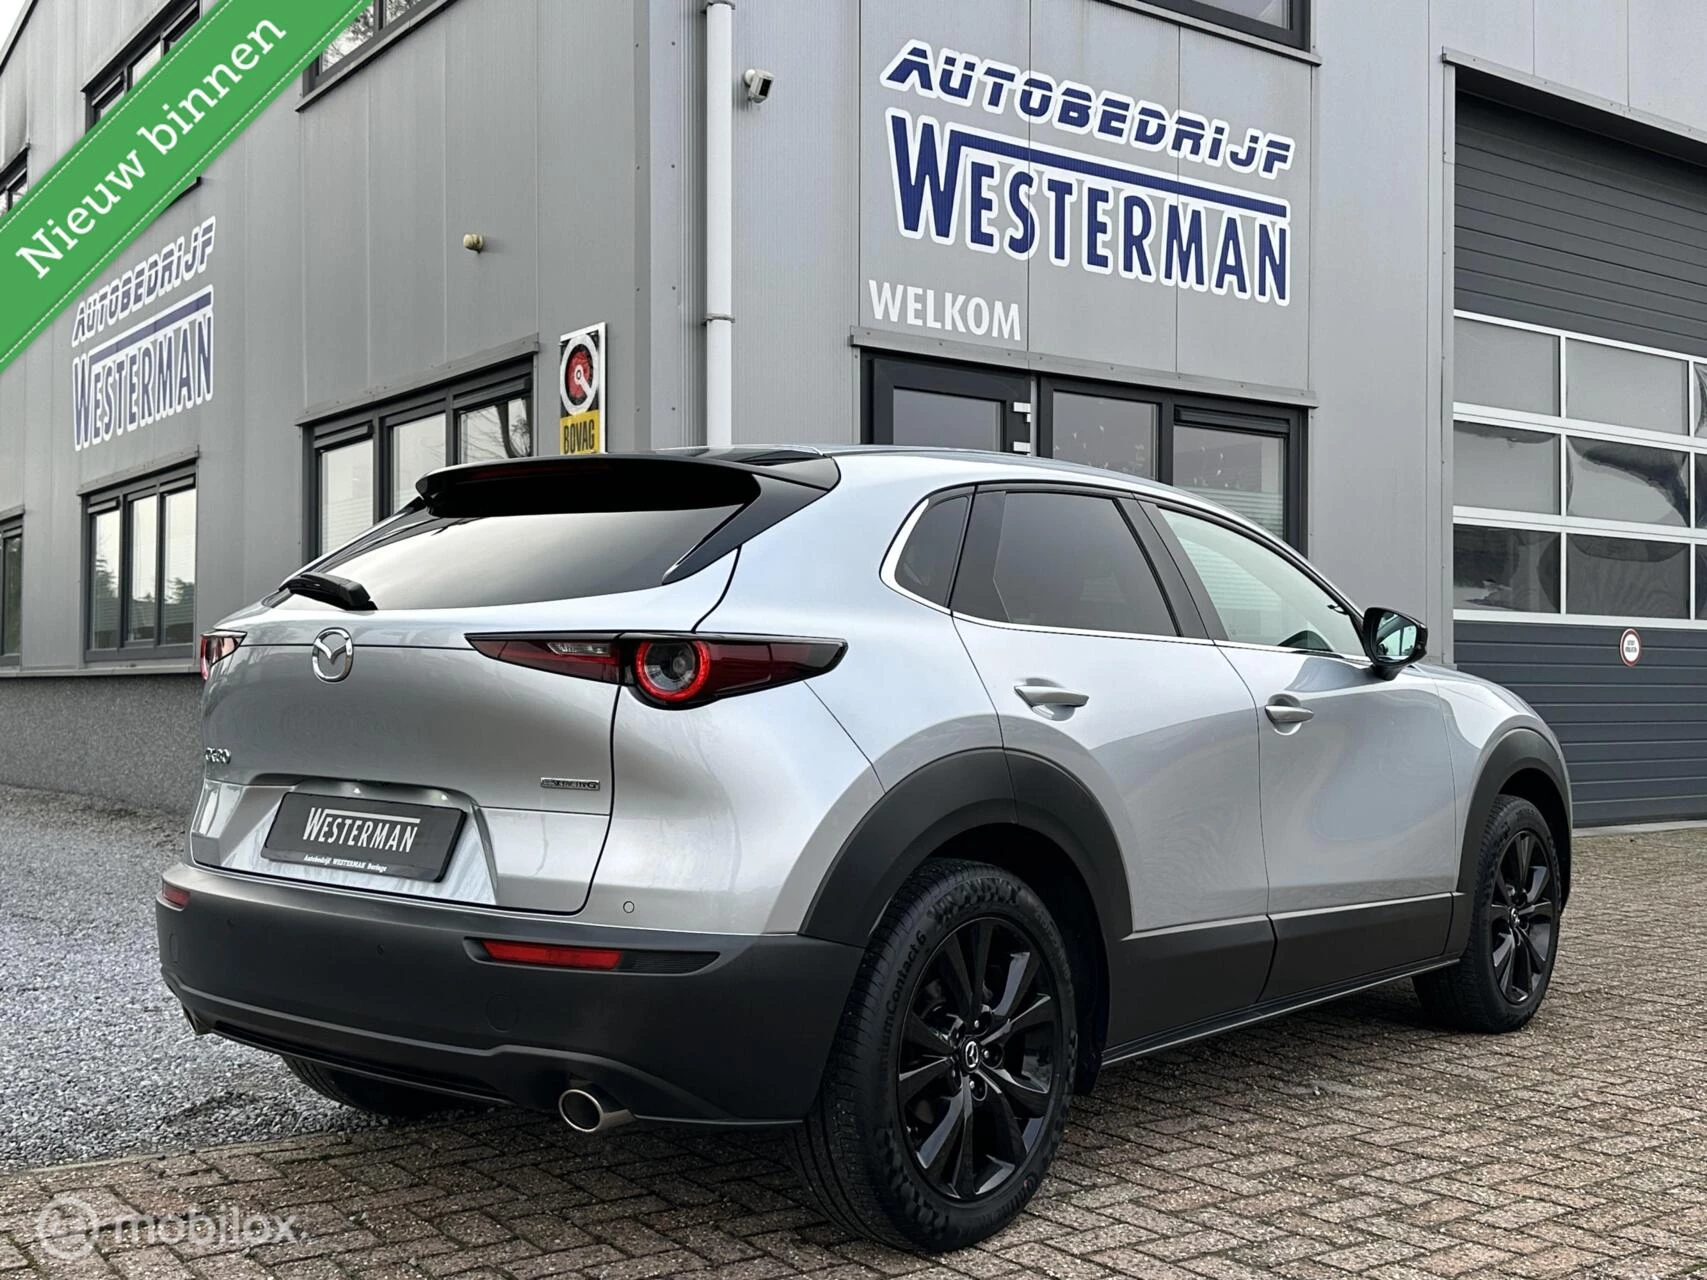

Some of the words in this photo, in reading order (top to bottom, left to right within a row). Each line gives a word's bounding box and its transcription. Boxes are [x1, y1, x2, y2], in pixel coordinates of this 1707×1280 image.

[880, 39, 1295, 180] AUTOBEDRIJF
[887, 108, 1290, 305] WESTERMAN
[72, 216, 216, 347] AUTOBEDRIJF
[868, 280, 1021, 341] WELKOM
[72, 284, 213, 452] WESTERMAN
[563, 419, 595, 454] BOVAG
[303, 807, 420, 853] WESTERMAN
